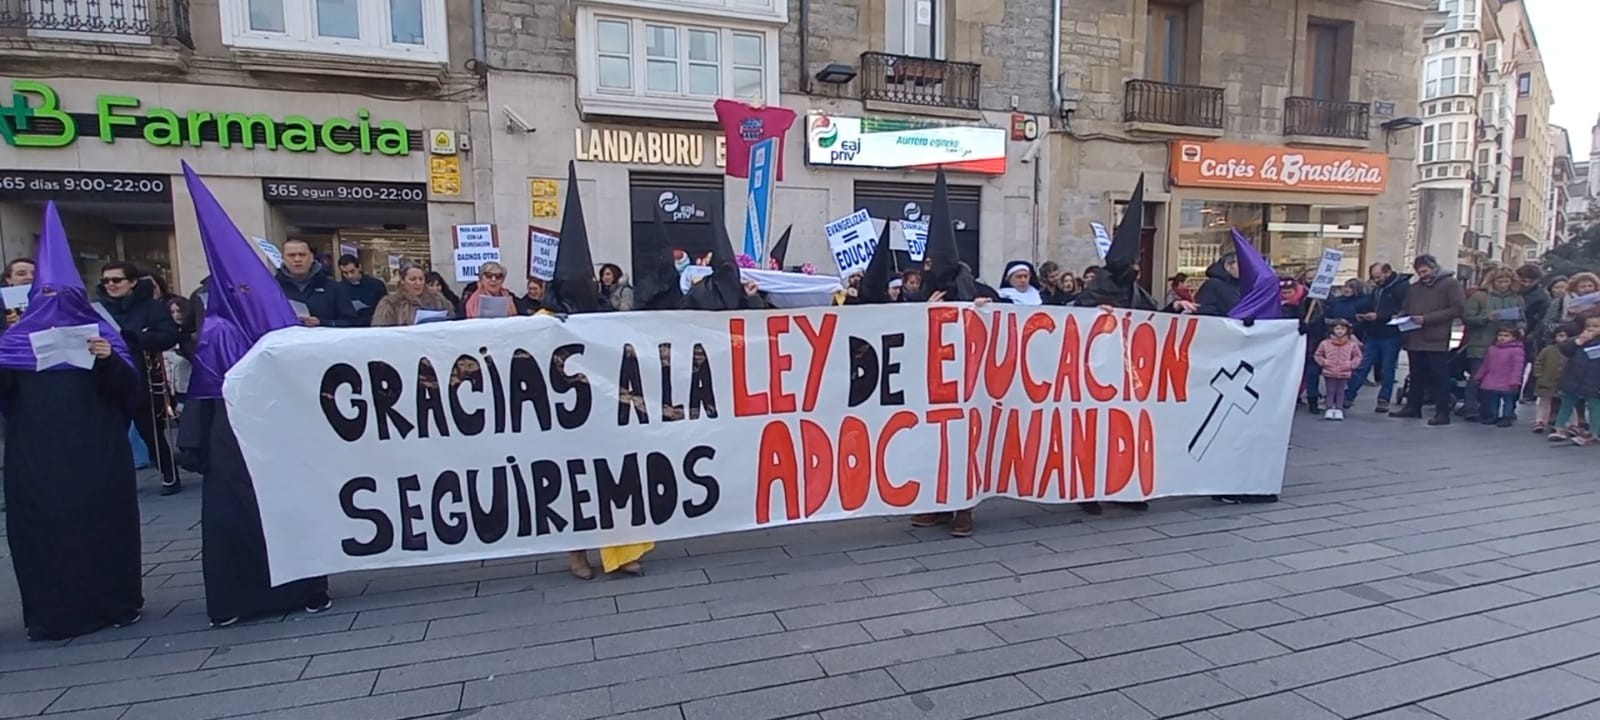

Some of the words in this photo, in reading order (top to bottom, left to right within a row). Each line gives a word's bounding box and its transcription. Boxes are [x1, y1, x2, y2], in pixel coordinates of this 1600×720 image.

[97, 94, 410, 156] Farmacia
[575, 128, 703, 166] LANDABURU
[830, 151, 856, 164] pnv
[841, 138, 861, 154] eaj
[1200, 158, 1255, 179] Cafés
[1260, 155, 1278, 180] la
[1281, 154, 1382, 185] Brasileña
[30, 178, 60, 190] días
[63, 178, 164, 192] 9:00-22:00
[268, 184, 298, 196] 365
[302, 189, 334, 199] egun
[337, 186, 423, 200] 9:00-22:00
[825, 211, 868, 237] EVANGELIZAR
[462, 266, 481, 276] MIL
[320, 343, 592, 442] GRACIAS
[728, 313, 838, 417] LEY
[848, 333, 905, 407] DE
[927, 305, 1198, 405] EDUCACIÓN
[339, 445, 720, 557] SEGUIREMOS
[756, 401, 1155, 525] ADOCTRINANDO
